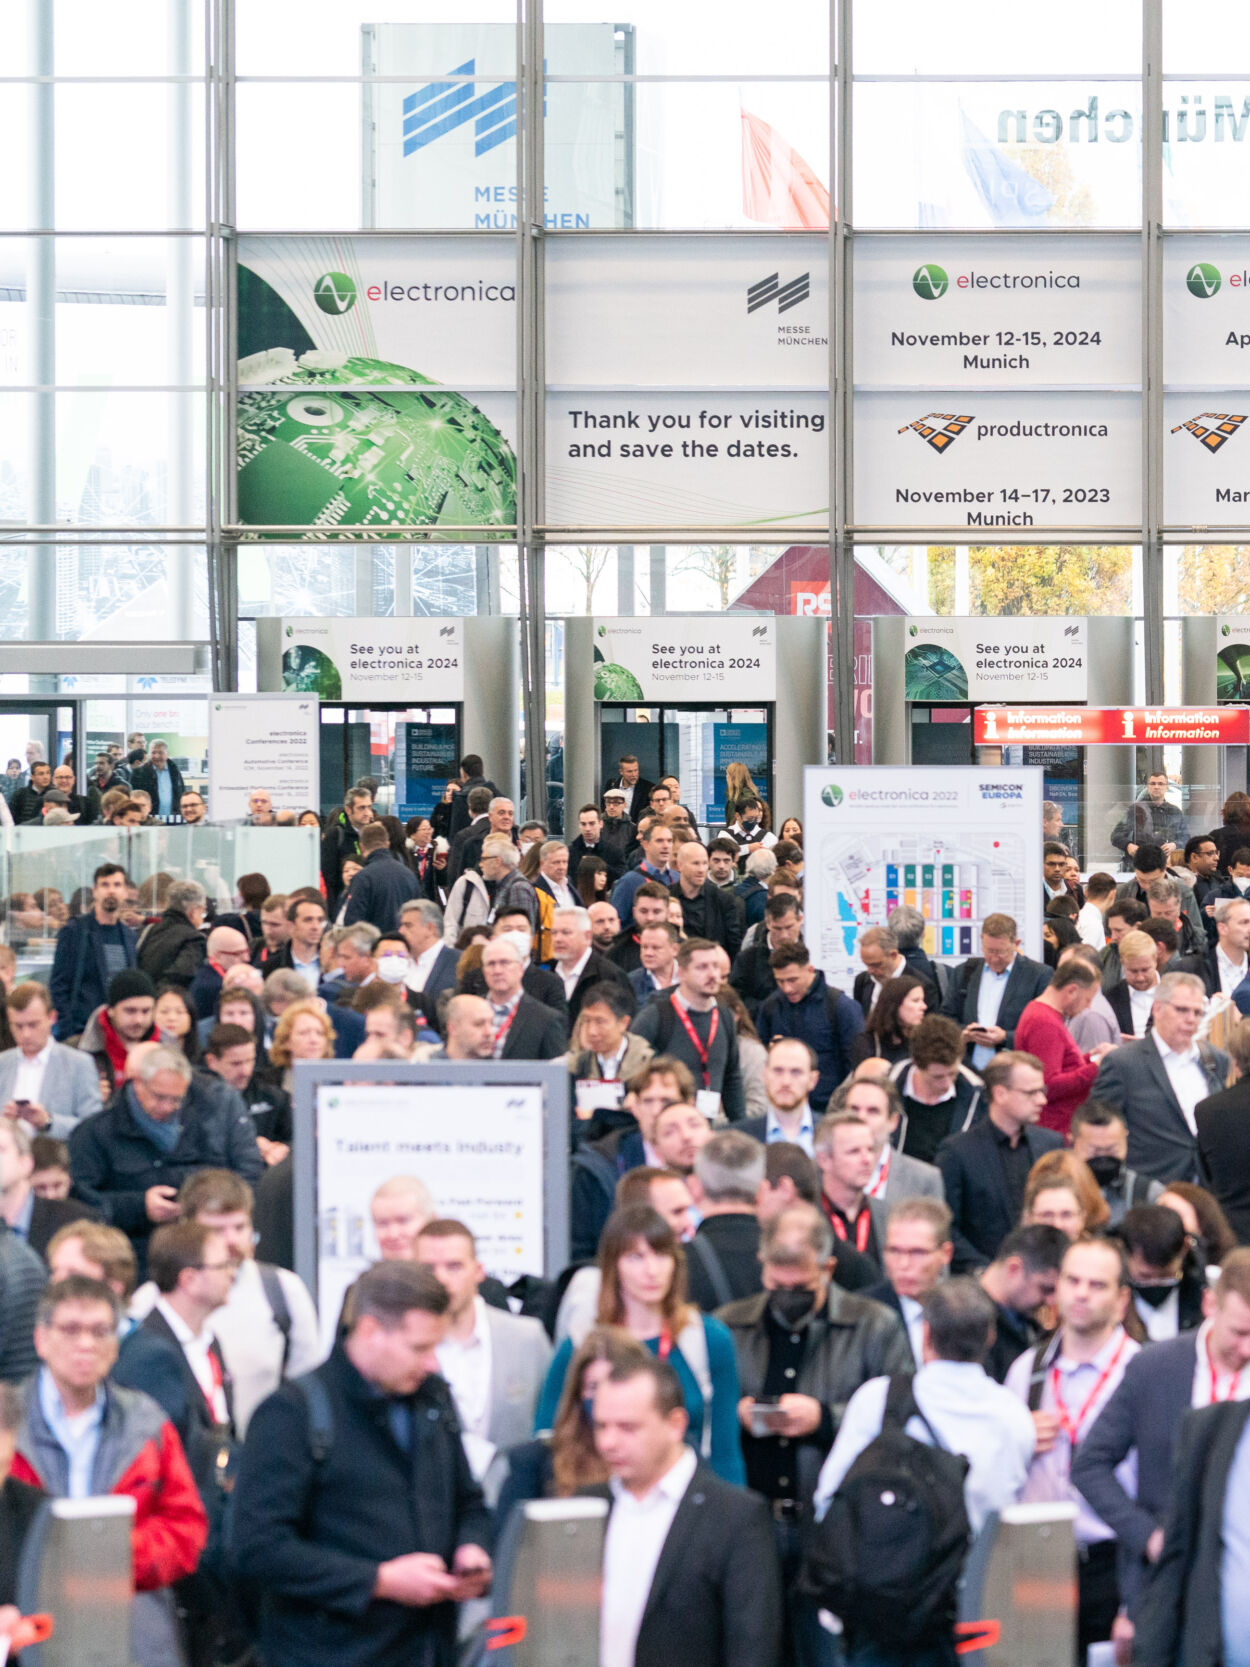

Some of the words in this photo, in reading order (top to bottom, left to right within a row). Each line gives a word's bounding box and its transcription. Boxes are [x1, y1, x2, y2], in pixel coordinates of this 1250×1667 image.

[957, 271, 1080, 288] electronica
[367, 279, 516, 303] electronica
[778, 335, 828, 346] MÜNCHEN
[892, 332, 990, 346] November
[996, 332, 1046, 348] 12-15,
[1053, 331, 1101, 345] 2024
[964, 354, 1029, 369] Munich
[568, 411, 640, 428] Thank
[648, 415, 690, 432] you
[699, 410, 732, 428] for
[740, 409, 824, 432] visiting
[976, 420, 1108, 441] productronica
[568, 440, 611, 457] and
[620, 444, 673, 457] save
[681, 440, 718, 457] the
[727, 440, 797, 457] dates.
[896, 489, 994, 503] November
[1063, 489, 1110, 502] 2023
[967, 511, 1033, 526] Munich
[351, 644, 374, 654] See
[378, 646, 402, 656] you
[407, 644, 419, 654] at
[652, 644, 675, 654] See
[680, 646, 703, 656] you
[709, 645, 720, 653] at
[976, 644, 1000, 653] See
[1005, 646, 1028, 656] you
[1033, 644, 1045, 653] at
[350, 658, 422, 669] electronica
[427, 658, 458, 668] 2024
[652, 658, 724, 669] electronica
[729, 658, 760, 668] 2024
[976, 658, 1048, 668] electronica
[1053, 658, 1082, 668] 2024
[350, 673, 398, 681] November
[652, 673, 699, 681] November
[1007, 711, 1081, 724] Information
[1145, 711, 1219, 724] Information
[1007, 727, 1082, 739] Information
[1145, 727, 1220, 738] Information
[849, 788, 928, 800] electronica
[932, 791, 958, 800] 2022
[336, 1140, 390, 1152] Talent
[396, 1140, 450, 1152] meets
[457, 1140, 522, 1156] Industry
